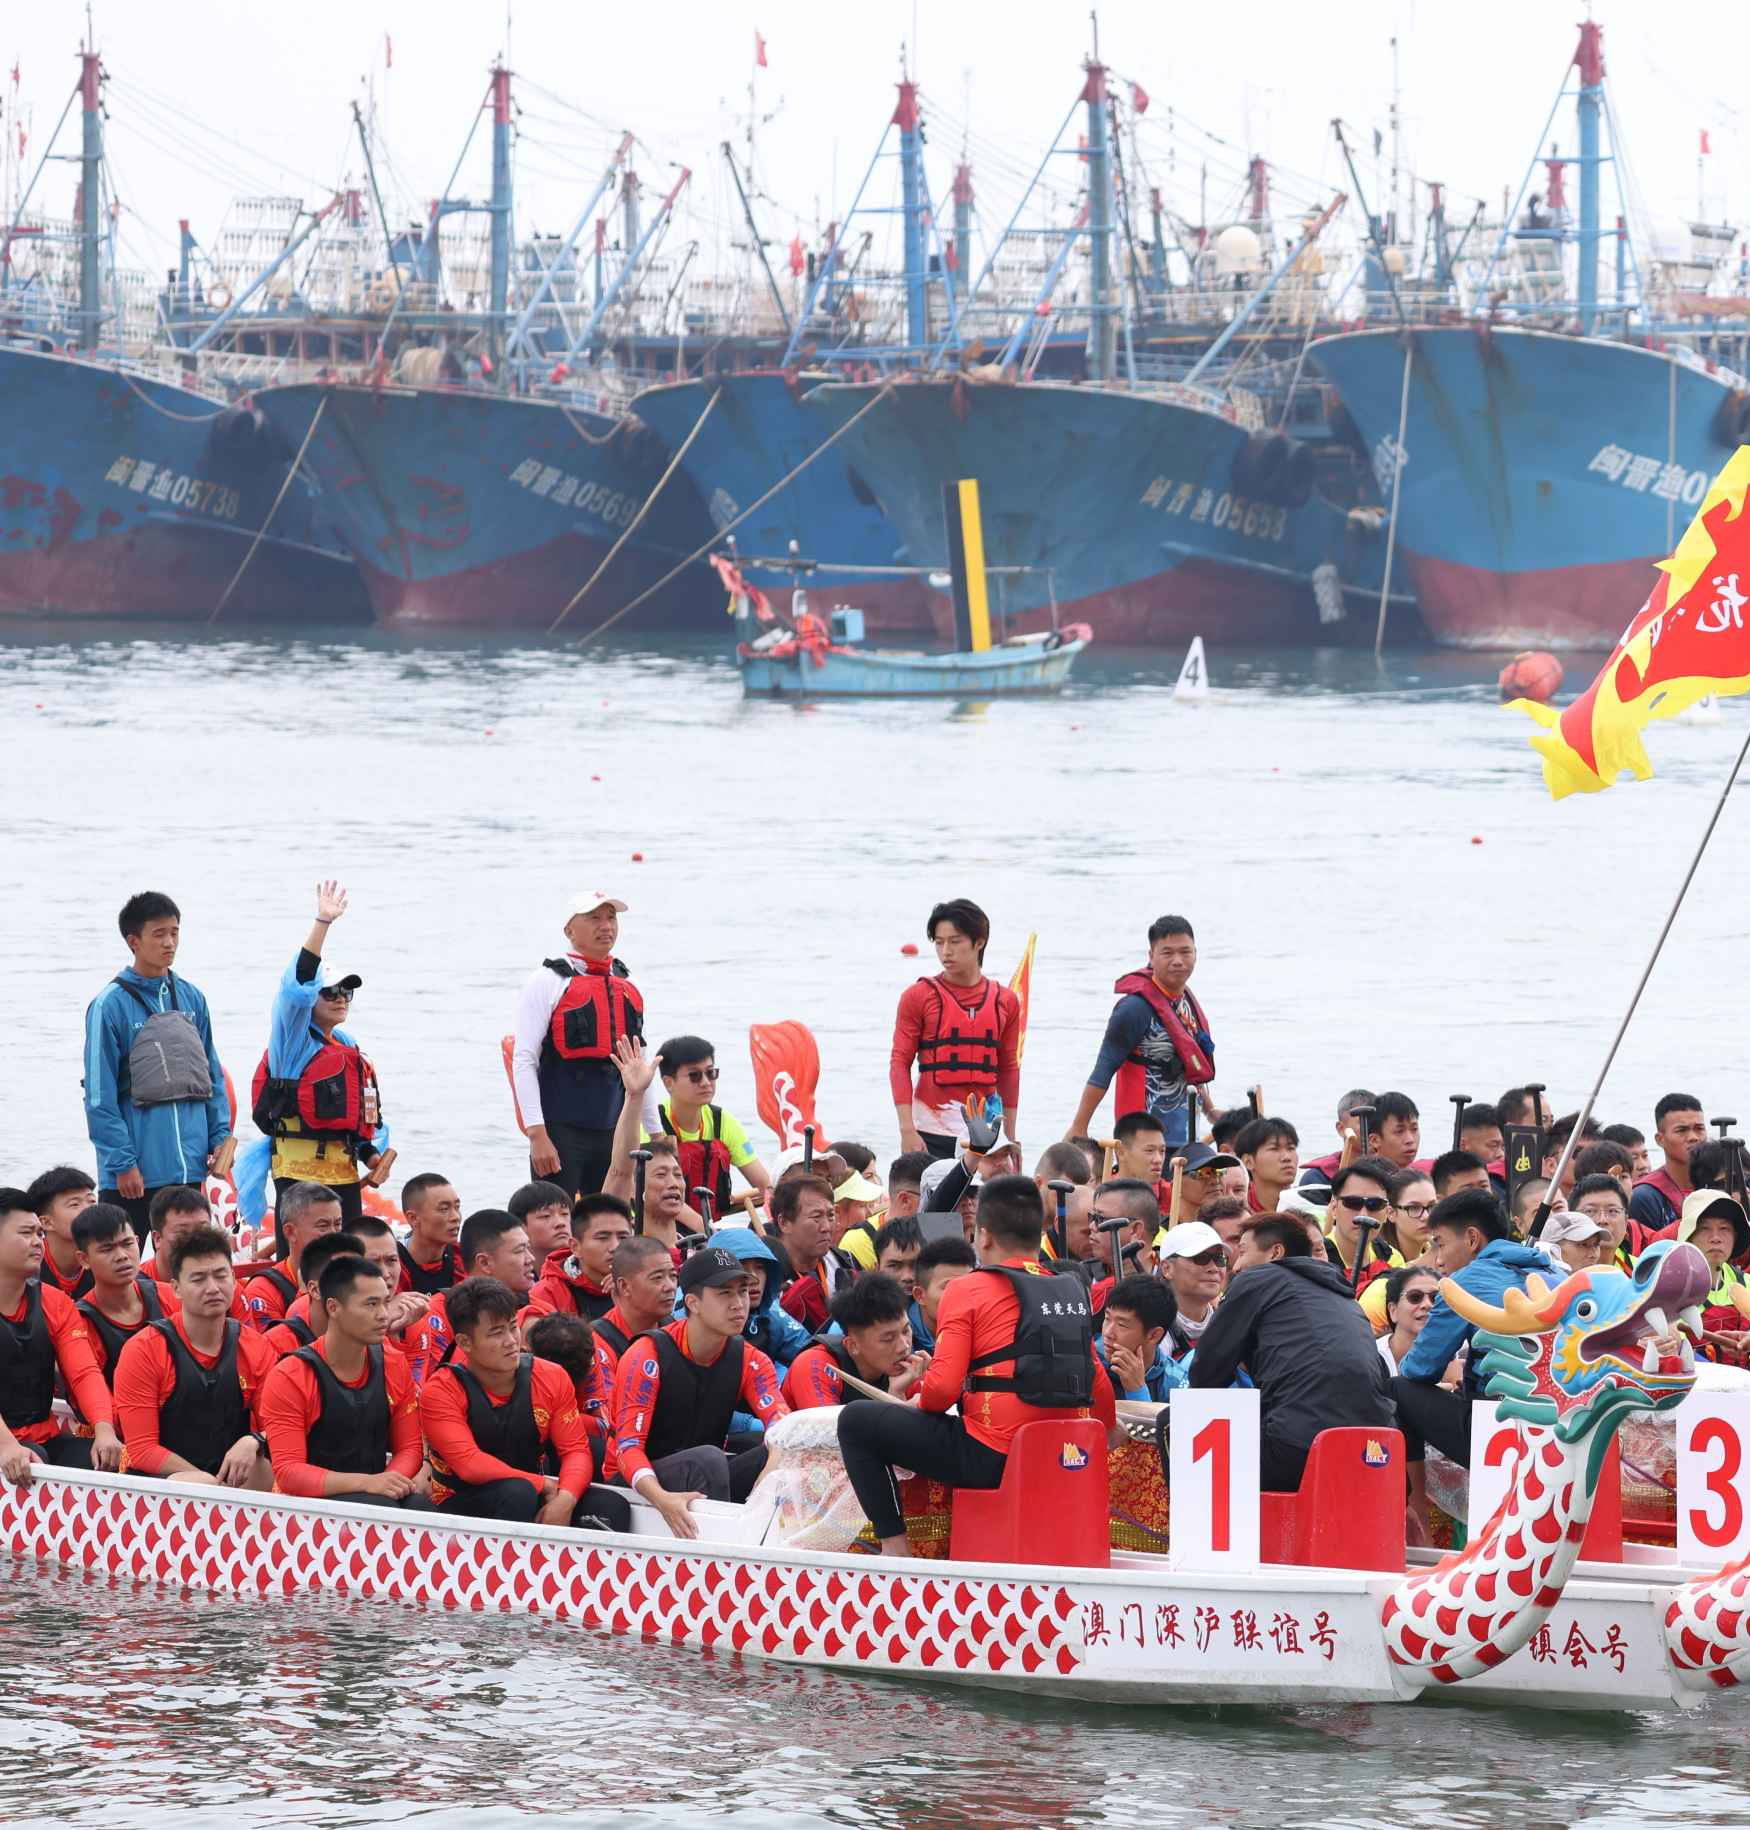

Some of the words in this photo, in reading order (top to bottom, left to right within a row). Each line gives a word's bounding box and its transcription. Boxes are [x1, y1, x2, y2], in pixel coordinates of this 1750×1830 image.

[1587, 443, 1717, 505] 闽晋渔0
[1184, 655, 1199, 687] 4
[1040, 1301, 1087, 1316] 东莞天马
[1192, 1418, 1231, 1552] 1
[1689, 1417, 1743, 1548] 3
[1081, 1601, 1338, 1661] 澳门深沪联谊号
